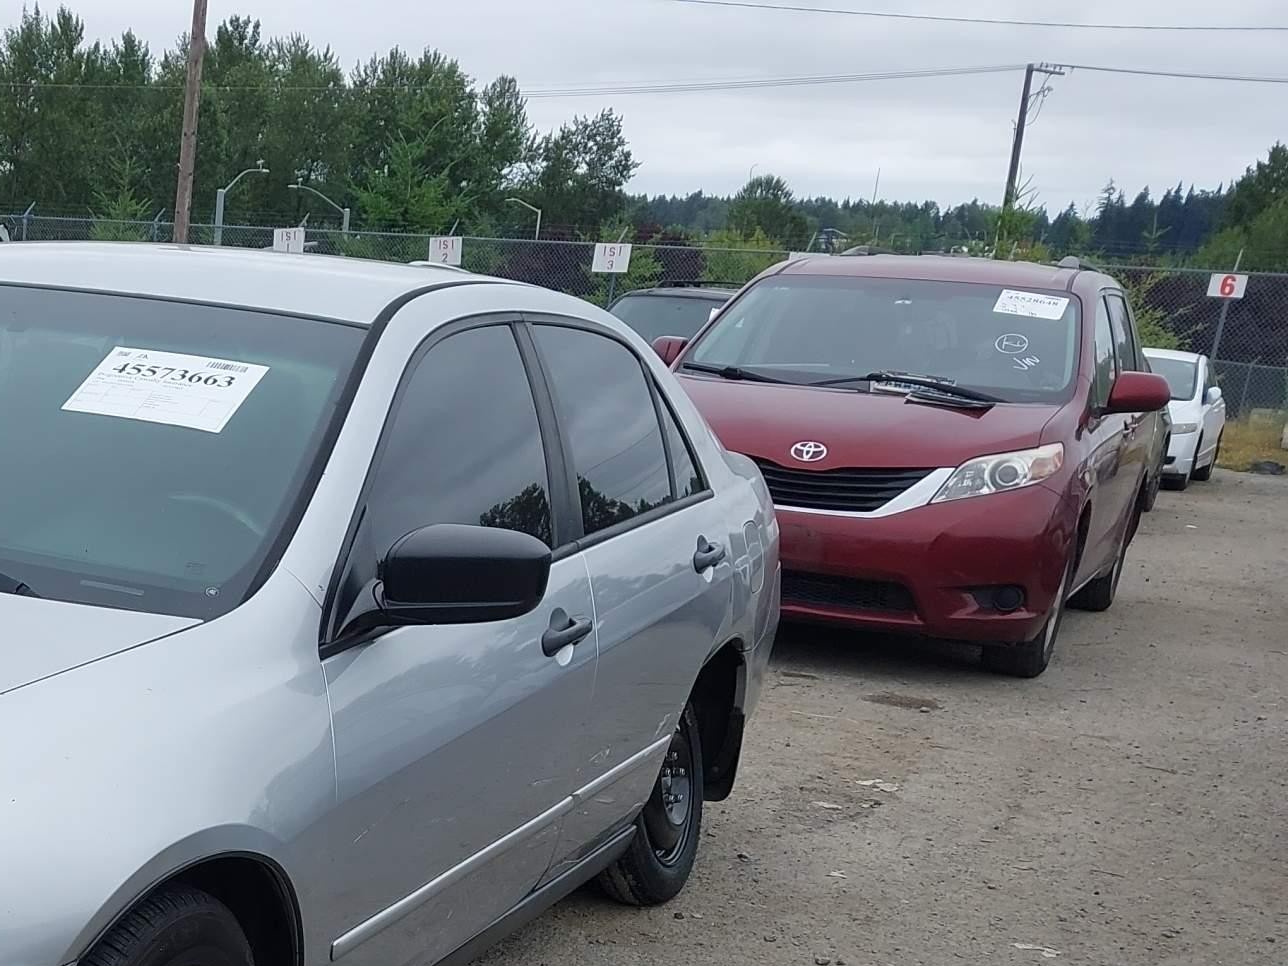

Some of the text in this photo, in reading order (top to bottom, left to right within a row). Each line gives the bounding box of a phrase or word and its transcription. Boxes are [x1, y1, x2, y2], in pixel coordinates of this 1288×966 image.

[441, 252, 449, 263] 2
[606, 259, 614, 271] 3
[1220, 275, 1236, 296] 6
[112, 363, 236, 388] 45573663
